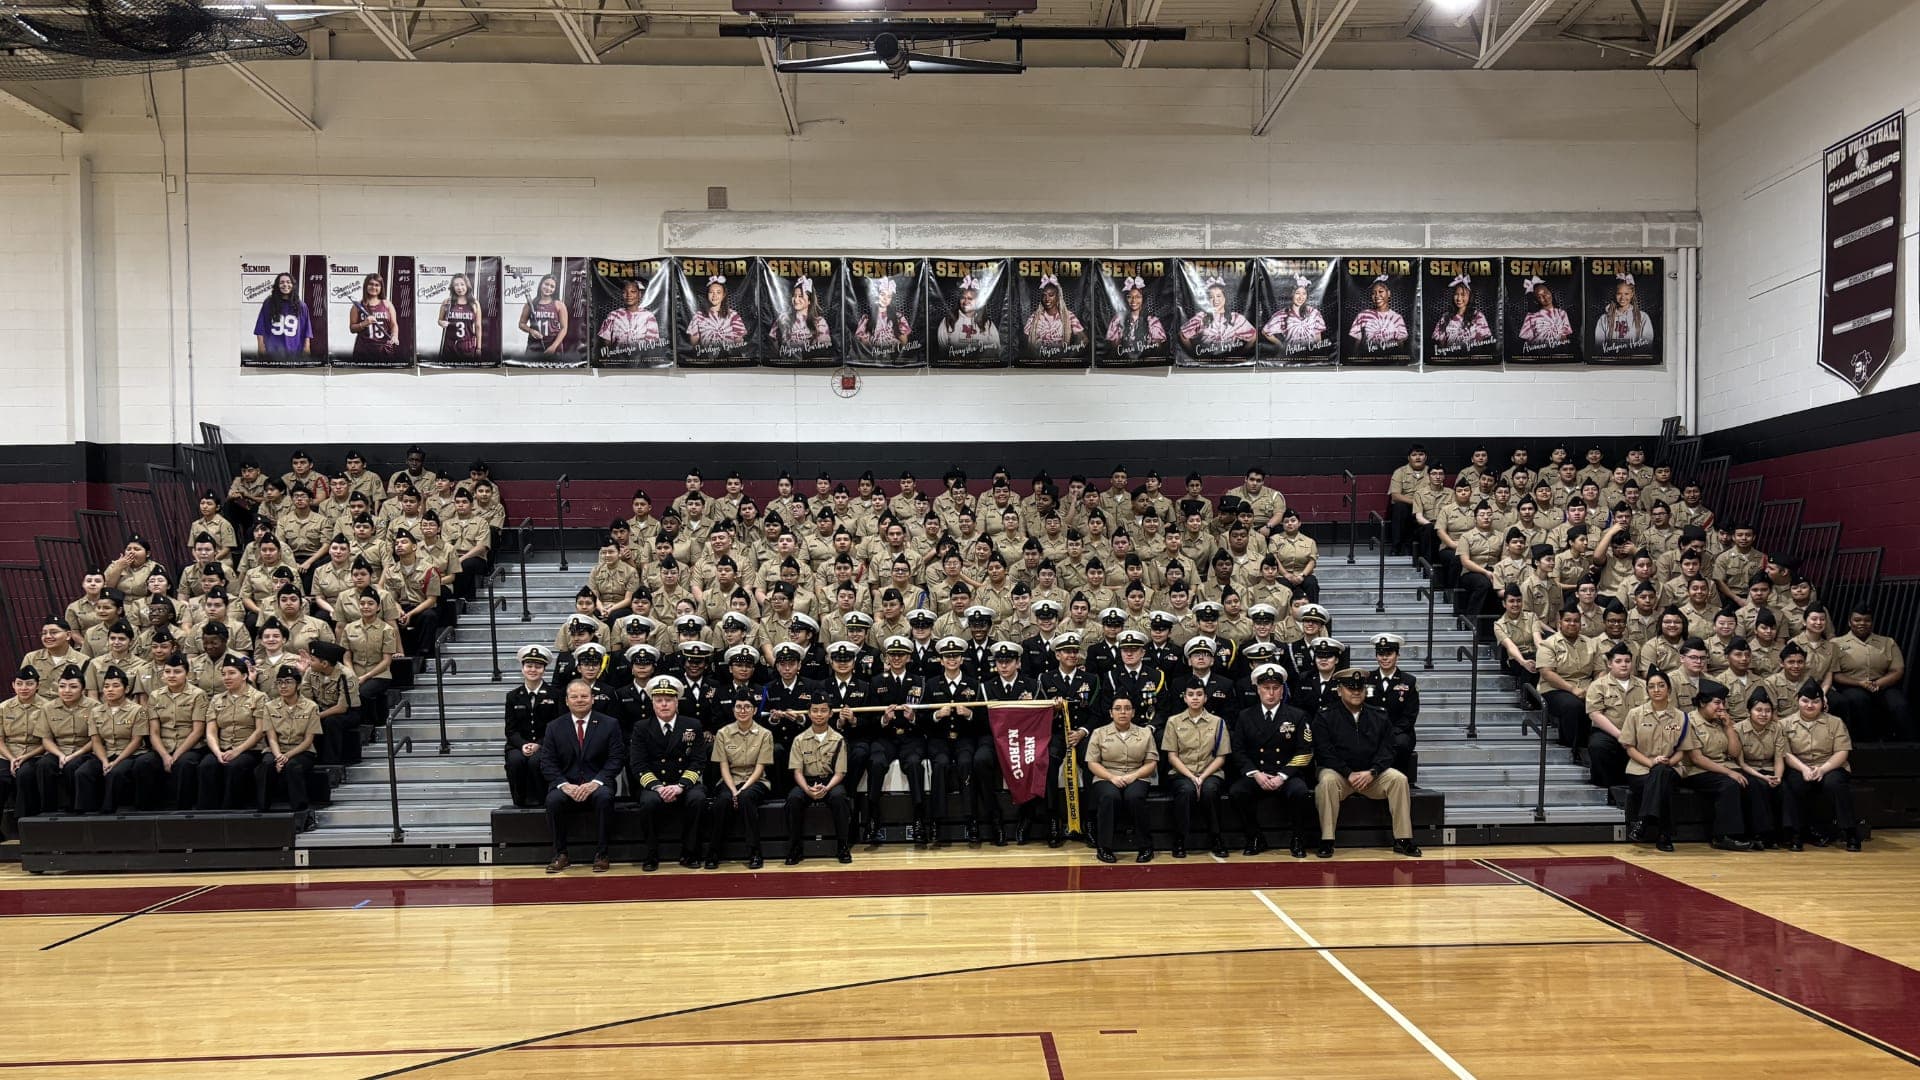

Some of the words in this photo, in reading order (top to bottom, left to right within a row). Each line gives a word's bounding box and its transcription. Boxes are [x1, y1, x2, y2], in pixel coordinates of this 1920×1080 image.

[1827, 145, 1847, 175] BOYS
[1848, 119, 1900, 157] VOLLEYBALL
[1828, 151, 1900, 193] CHAMPIONSHIPS
[242, 264, 271, 273] SENIOR
[330, 265, 359, 273] SENIOR
[597, 260, 662, 278] SENIOR
[683, 260, 747, 277] SENIOR
[768, 260, 832, 277] SENIOR
[852, 260, 916, 278] SENIOR
[936, 260, 999, 278] SENIOR
[1019, 260, 1082, 277] SENIOR
[1101, 261, 1165, 278] SENIOR
[1183, 260, 1247, 278] SENIOR
[1266, 259, 1329, 275] SENIOR
[1348, 260, 1411, 276] SENIOR
[1430, 260, 1492, 276] SENIOR
[1510, 260, 1573, 276] SENIOR
[1591, 260, 1654, 276] SENIOR
[447, 311, 474, 321] CANUCKS
[271, 314, 298, 337] 99
[368, 321, 385, 339] 15
[455, 321, 466, 338] 3
[537, 320, 549, 337] 11
[1008, 728, 1024, 780] NJROTC
